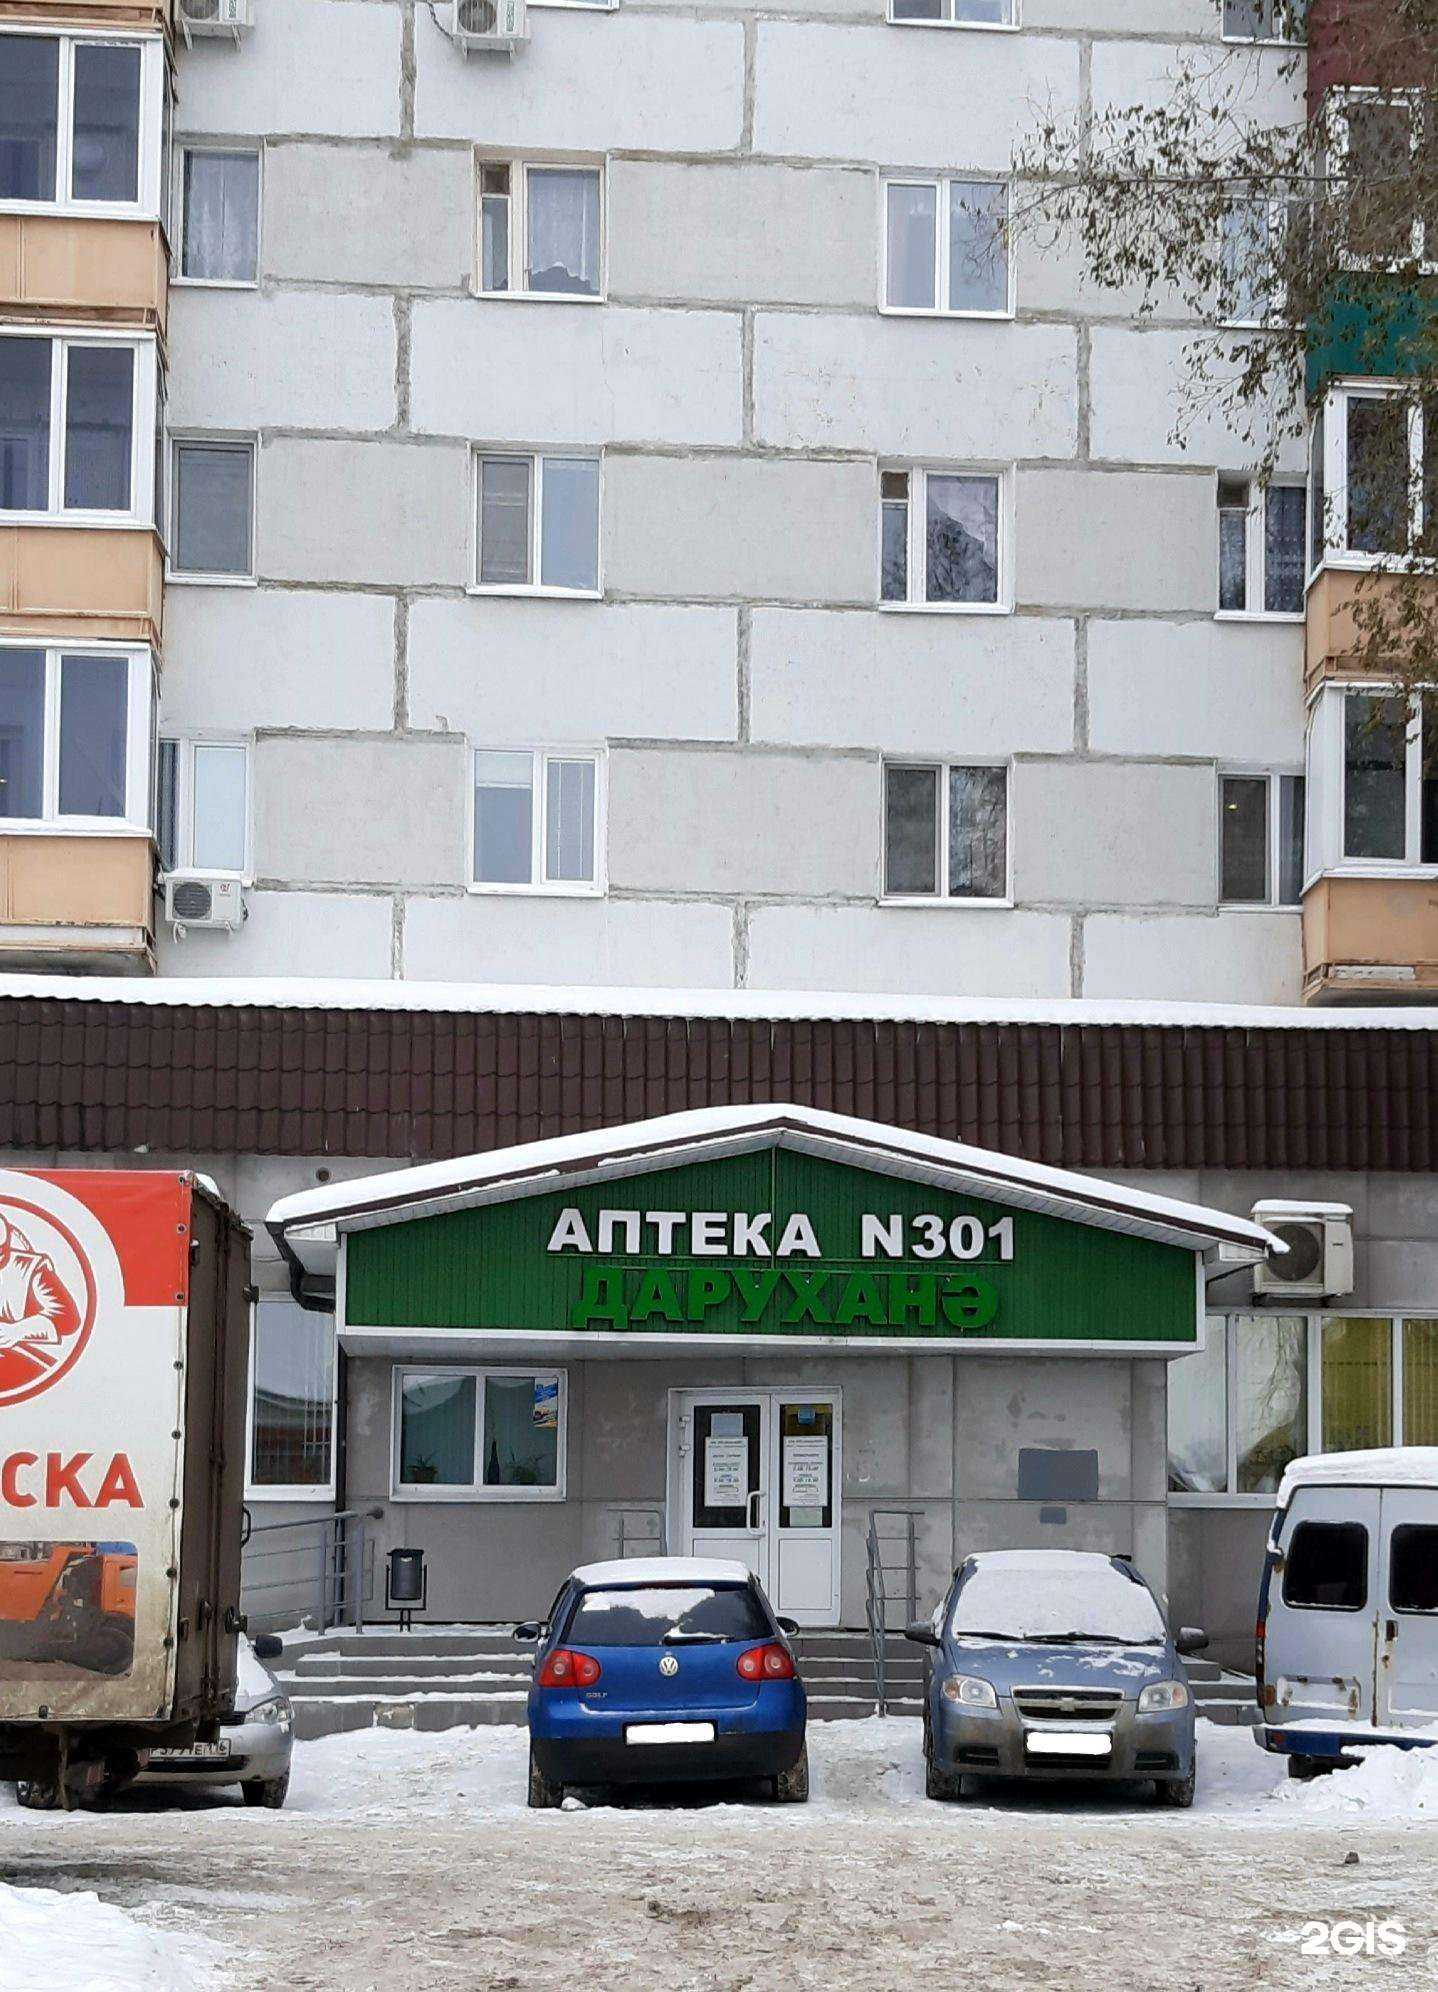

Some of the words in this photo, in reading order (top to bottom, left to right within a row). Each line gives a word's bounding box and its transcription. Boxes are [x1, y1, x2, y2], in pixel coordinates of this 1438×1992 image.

[547, 1208, 822, 1257] АПТЕКА
[861, 1213, 1014, 1261] N301
[571, 1265, 999, 1330] ДАРУХАНӘ
[1, 1451, 145, 1508] СКА
